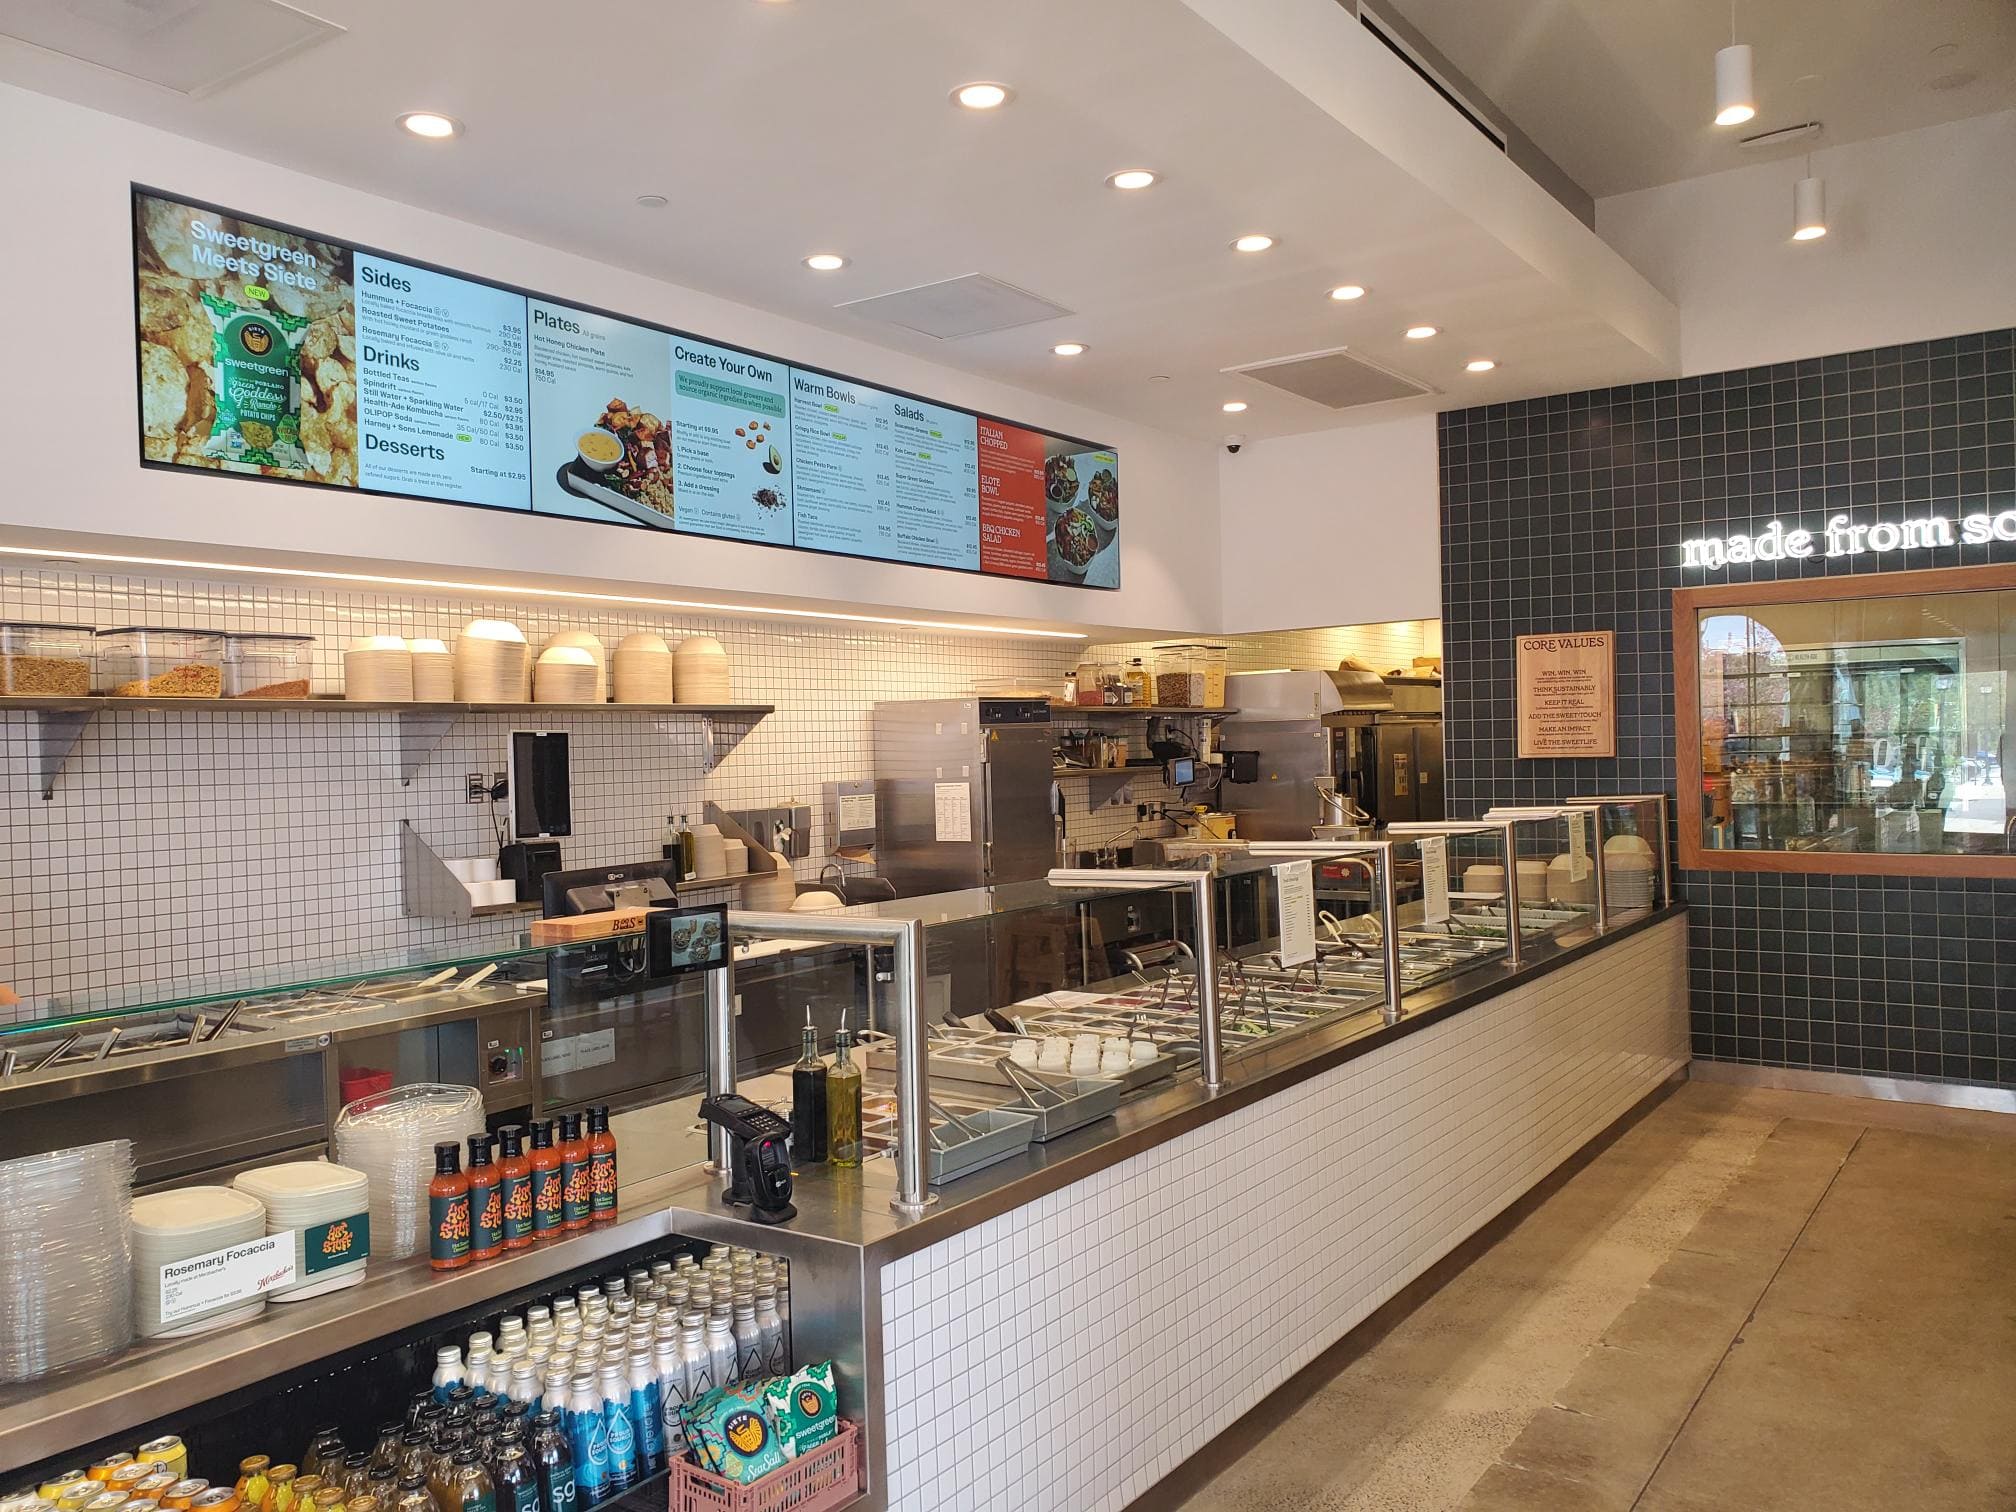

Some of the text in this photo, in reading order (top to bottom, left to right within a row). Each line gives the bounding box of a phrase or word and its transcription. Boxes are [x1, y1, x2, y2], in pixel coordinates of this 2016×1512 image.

[191, 220, 317, 269] Sweetgreen
[192, 244, 317, 290] Meets Siete
[362, 266, 411, 293] Sides
[249, 288, 266, 297] NEW
[362, 290, 394, 304] Hummus
[401, 300, 433, 313] Focaccia
[362, 307, 392, 320] Roasted
[394, 314, 416, 326] Sweet
[418, 320, 449, 333] Potatoes
[534, 309, 580, 334] Plates
[362, 325, 399, 341] Rosemary
[401, 335, 432, 347] Focaccia
[534, 334, 605, 356] Hot Honey Chicken Plate
[364, 345, 419, 371] Drinks
[675, 346, 772, 382] Create Your Own
[225, 358, 288, 377] sweetgreen
[363, 368, 409, 383] Bottled Teas
[364, 378, 397, 390] Spindrift
[678, 375, 687, 383] We
[689, 378, 708, 389] proudly
[710, 384, 730, 393] support
[731, 388, 742, 396] local
[794, 377, 856, 404] Warm Bowls
[364, 388, 378, 397] Still
[380, 390, 401, 401] Water
[409, 396, 442, 409] Sparkling
[444, 403, 464, 412] Water
[504, 396, 522, 404] $3.50
[679, 385, 697, 393] source
[698, 389, 718, 398] organic
[719, 392, 747, 405] ingredients
[240, 409, 276, 421] POTATO CHIPS
[364, 397, 443, 417] Health-Ade Kombucha
[364, 408, 412, 422] OLIPOP Soda
[505, 405, 523, 414] $2.95
[895, 404, 924, 421] Salads
[483, 410, 523, 423] $2.50/$2.75
[364, 419, 391, 430] Harney
[398, 424, 416, 433] Sons
[417, 428, 453, 439] Lemonade
[505, 423, 523, 431] $3.95
[677, 421, 697, 431] Starting
[795, 425, 809, 433] Crispy
[980, 427, 1003, 439] ITALIAN
[505, 433, 524, 441] $3.50
[981, 436, 1008, 450] CHOPPED
[366, 434, 445, 461] Desserts
[505, 443, 524, 451] $3.50
[470, 466, 498, 477] Starting
[508, 472, 526, 480] $2.95
[683, 464, 702, 473] Choose
[982, 475, 1000, 487] ELOTE
[982, 485, 999, 496] BOWL
[982, 533, 1002, 543] SALAD
[995, 526, 1020, 537] CHICKEN
[1682, 520, 1813, 568] made
[1824, 514, 1954, 557] from
[1524, 637, 1604, 652] CORE VALUES
[1553, 685, 1596, 693] SUSTAINABLY
[591, 1159, 614, 1179] HOT
[328, 1222, 348, 1241] HOT
[323, 1232, 352, 1252] STUFF
[165, 1241, 275, 1279] Rosemary Focaccia
[728, 1415, 747, 1429] SIETE
[796, 1415, 836, 1439] sweetgreen
[610, 1434, 631, 1442] SOURCE
[748, 1452, 780, 1482] Sea Salt
[553, 1480, 575, 1504] sg
